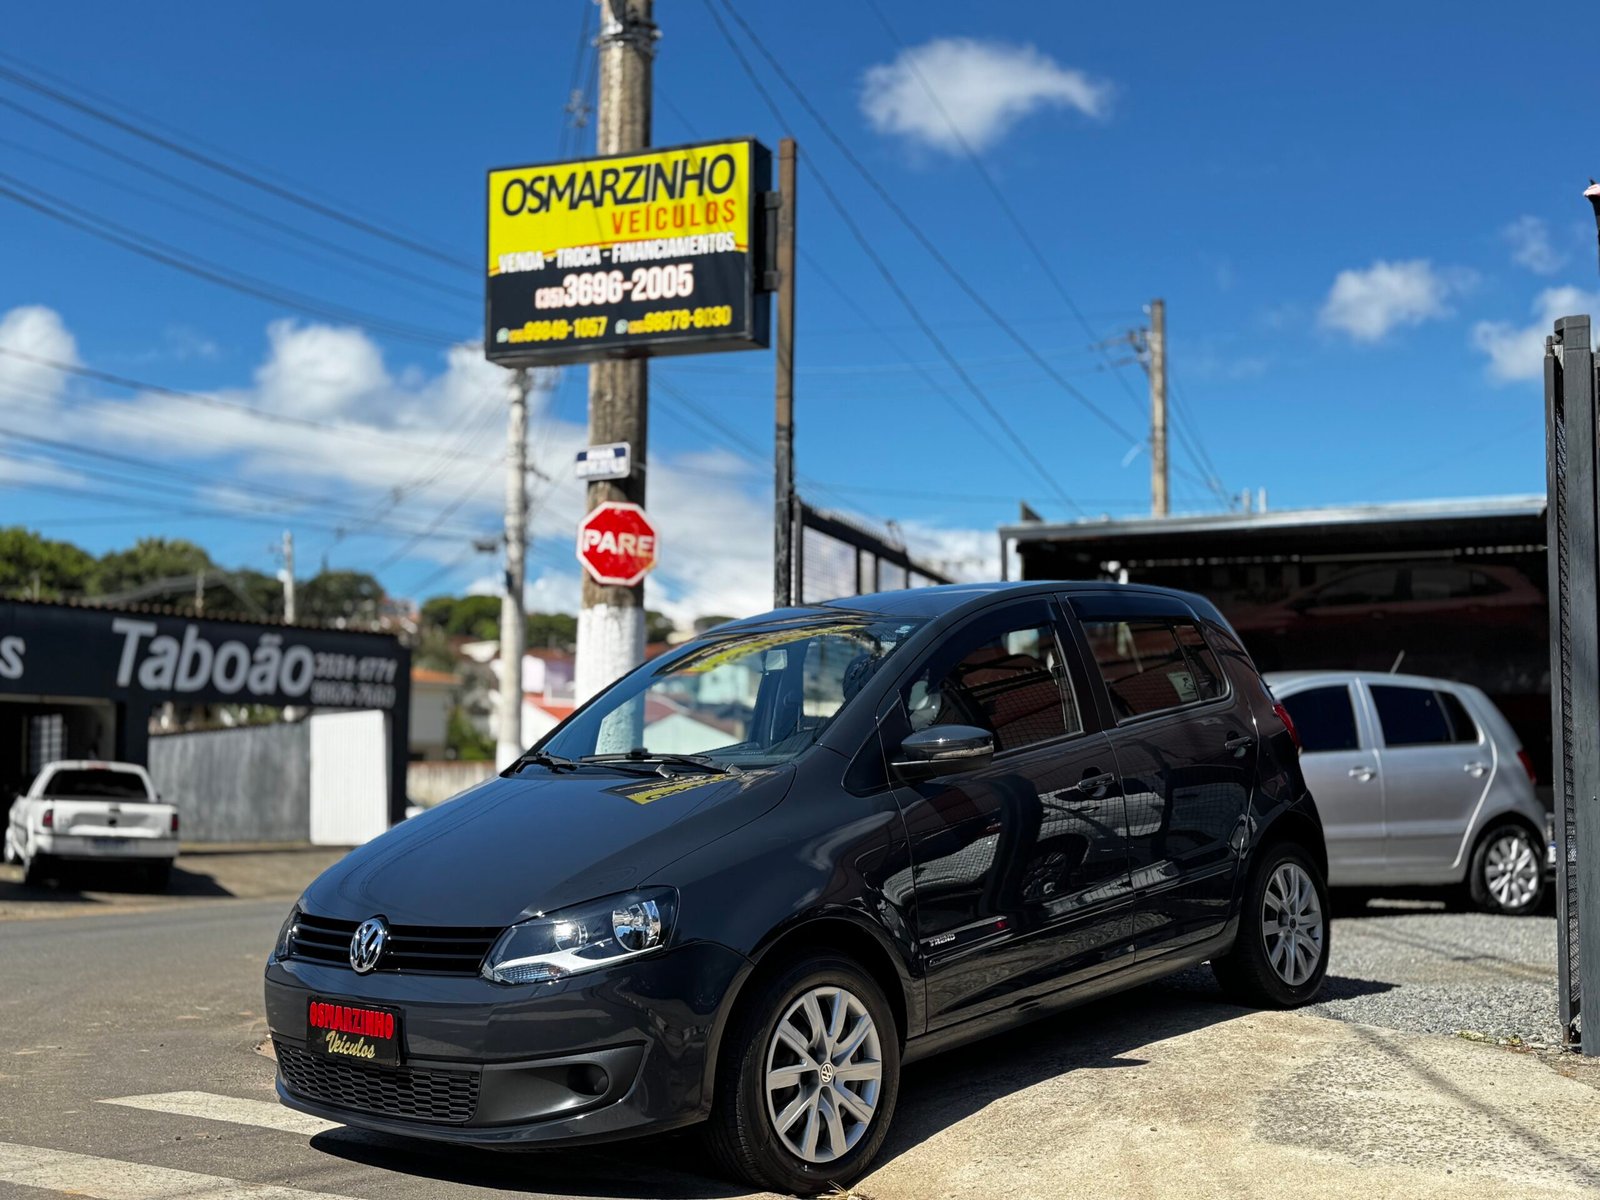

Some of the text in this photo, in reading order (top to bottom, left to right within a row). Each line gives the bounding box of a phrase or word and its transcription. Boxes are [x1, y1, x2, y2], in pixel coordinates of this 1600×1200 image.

[502, 153, 736, 216] OSMARZINHO
[612, 199, 736, 235] VEÍCULOS
[498, 250, 545, 273] VENDA
[556, 245, 602, 269] TROCA
[612, 232, 736, 264] FINANCIAMENTOS
[583, 529, 655, 558] PARE
[112, 617, 316, 697] Taboão
[309, 1001, 394, 1040] OSMARZINHO
